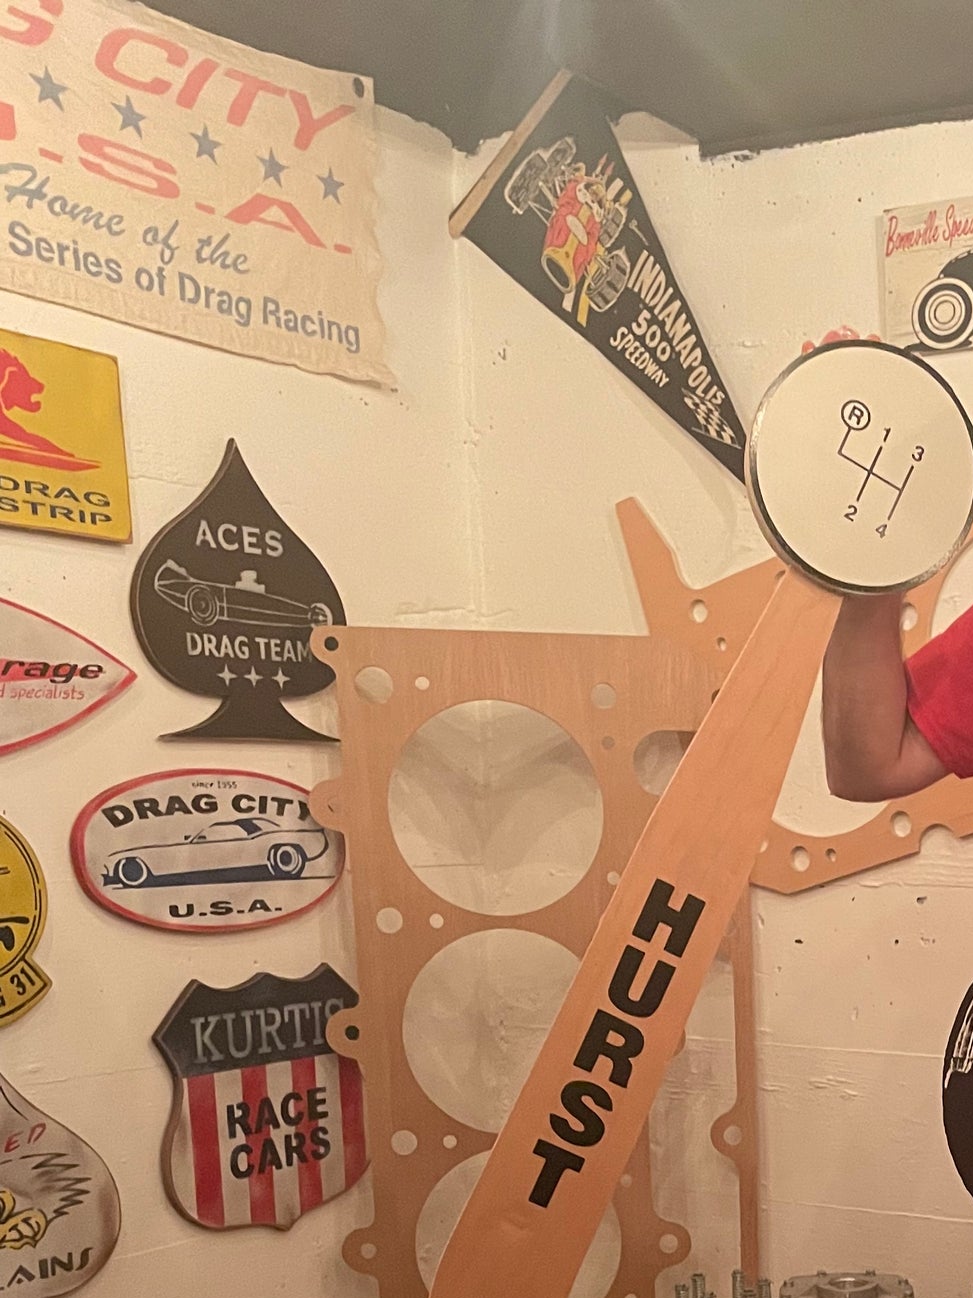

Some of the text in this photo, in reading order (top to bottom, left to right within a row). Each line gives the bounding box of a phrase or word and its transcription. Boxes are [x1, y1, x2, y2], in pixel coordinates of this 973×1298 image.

[95, 28, 356, 151] CITY
[0, 162, 251, 275] Home of the
[886, 210, 939, 257] Bonneville
[8, 220, 361, 354] Series of Drag Racing
[627, 249, 725, 405] INDIANAPOLIS
[632, 309, 671, 362] 500
[610, 326, 669, 388] SPEEDWAY
[883, 427, 892, 442] 1
[911, 445, 925, 462] 3
[0, 475, 111, 507] DRAG
[195, 519, 284, 557] ACES
[844, 504, 888, 539] 2 4
[186, 632, 313, 663] DRAG TEAM
[10, 684, 85, 700] specialists
[101, 793, 219, 828] DRAG
[168, 899, 283, 919] U.S.A.
[9, 967, 36, 996] 31
[528, 878, 706, 1209] HURST
[226, 1086, 329, 1139] RACE
[230, 1126, 331, 1180] CARS
[0, 1247, 94, 1291] AINS
